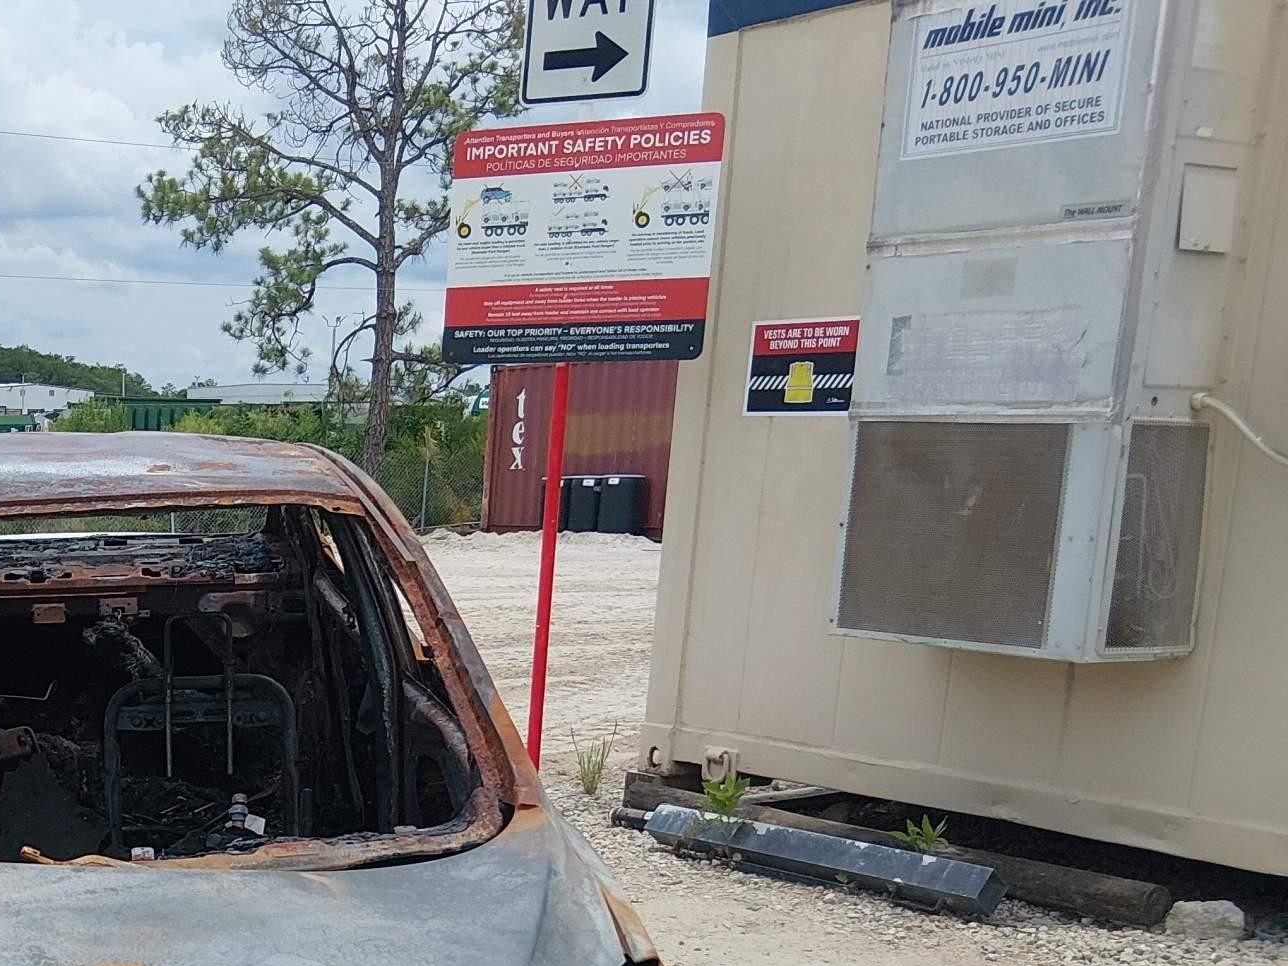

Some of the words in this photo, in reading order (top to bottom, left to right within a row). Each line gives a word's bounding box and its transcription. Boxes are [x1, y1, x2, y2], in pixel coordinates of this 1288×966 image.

[922, 4, 1006, 50] mobile
[920, 49, 1111, 109] 1-800-950-MINI
[914, 130, 969, 146] PORTABLE
[972, 123, 1023, 138] STORAGE
[1027, 118, 1051, 132] AND
[1054, 111, 1105, 128] OFFICES
[920, 115, 972, 132] NATIONAL
[976, 108, 1032, 124] PROVIDER
[1035, 104, 1050, 116] OF
[1054, 96, 1102, 112] SECURE
[466, 141, 559, 160] IMPORTANT
[562, 135, 626, 154] SAFETY
[630, 129, 712, 149] POLICIES
[486, 158, 535, 172] POLÍTICAS
[537, 159, 551, 168] DE
[553, 154, 612, 168] SEGURIDAD
[615, 149, 686, 162] IMPORTANTES
[454, 330, 485, 338] SAFETY:
[487, 329, 506, 337] OUR
[507, 328, 523, 336] TOP
[524, 327, 562, 336] PRIORITY
[624, 324, 695, 334] RESPONSIBILITY
[764, 329, 786, 340] VESTS
[786, 328, 802, 339] ARE
[803, 328, 813, 338] TO
[814, 327, 825, 337] BE
[825, 326, 850, 336] WORN
[769, 339, 799, 350] BEYOND
[800, 338, 817, 348] THIS
[818, 337, 842, 347] POINT
[497, 345, 529, 354] operators
[544, 345, 557, 353] say
[598, 342, 624, 351] loading
[626, 341, 670, 350] transporters
[509, 388, 527, 470] tex
